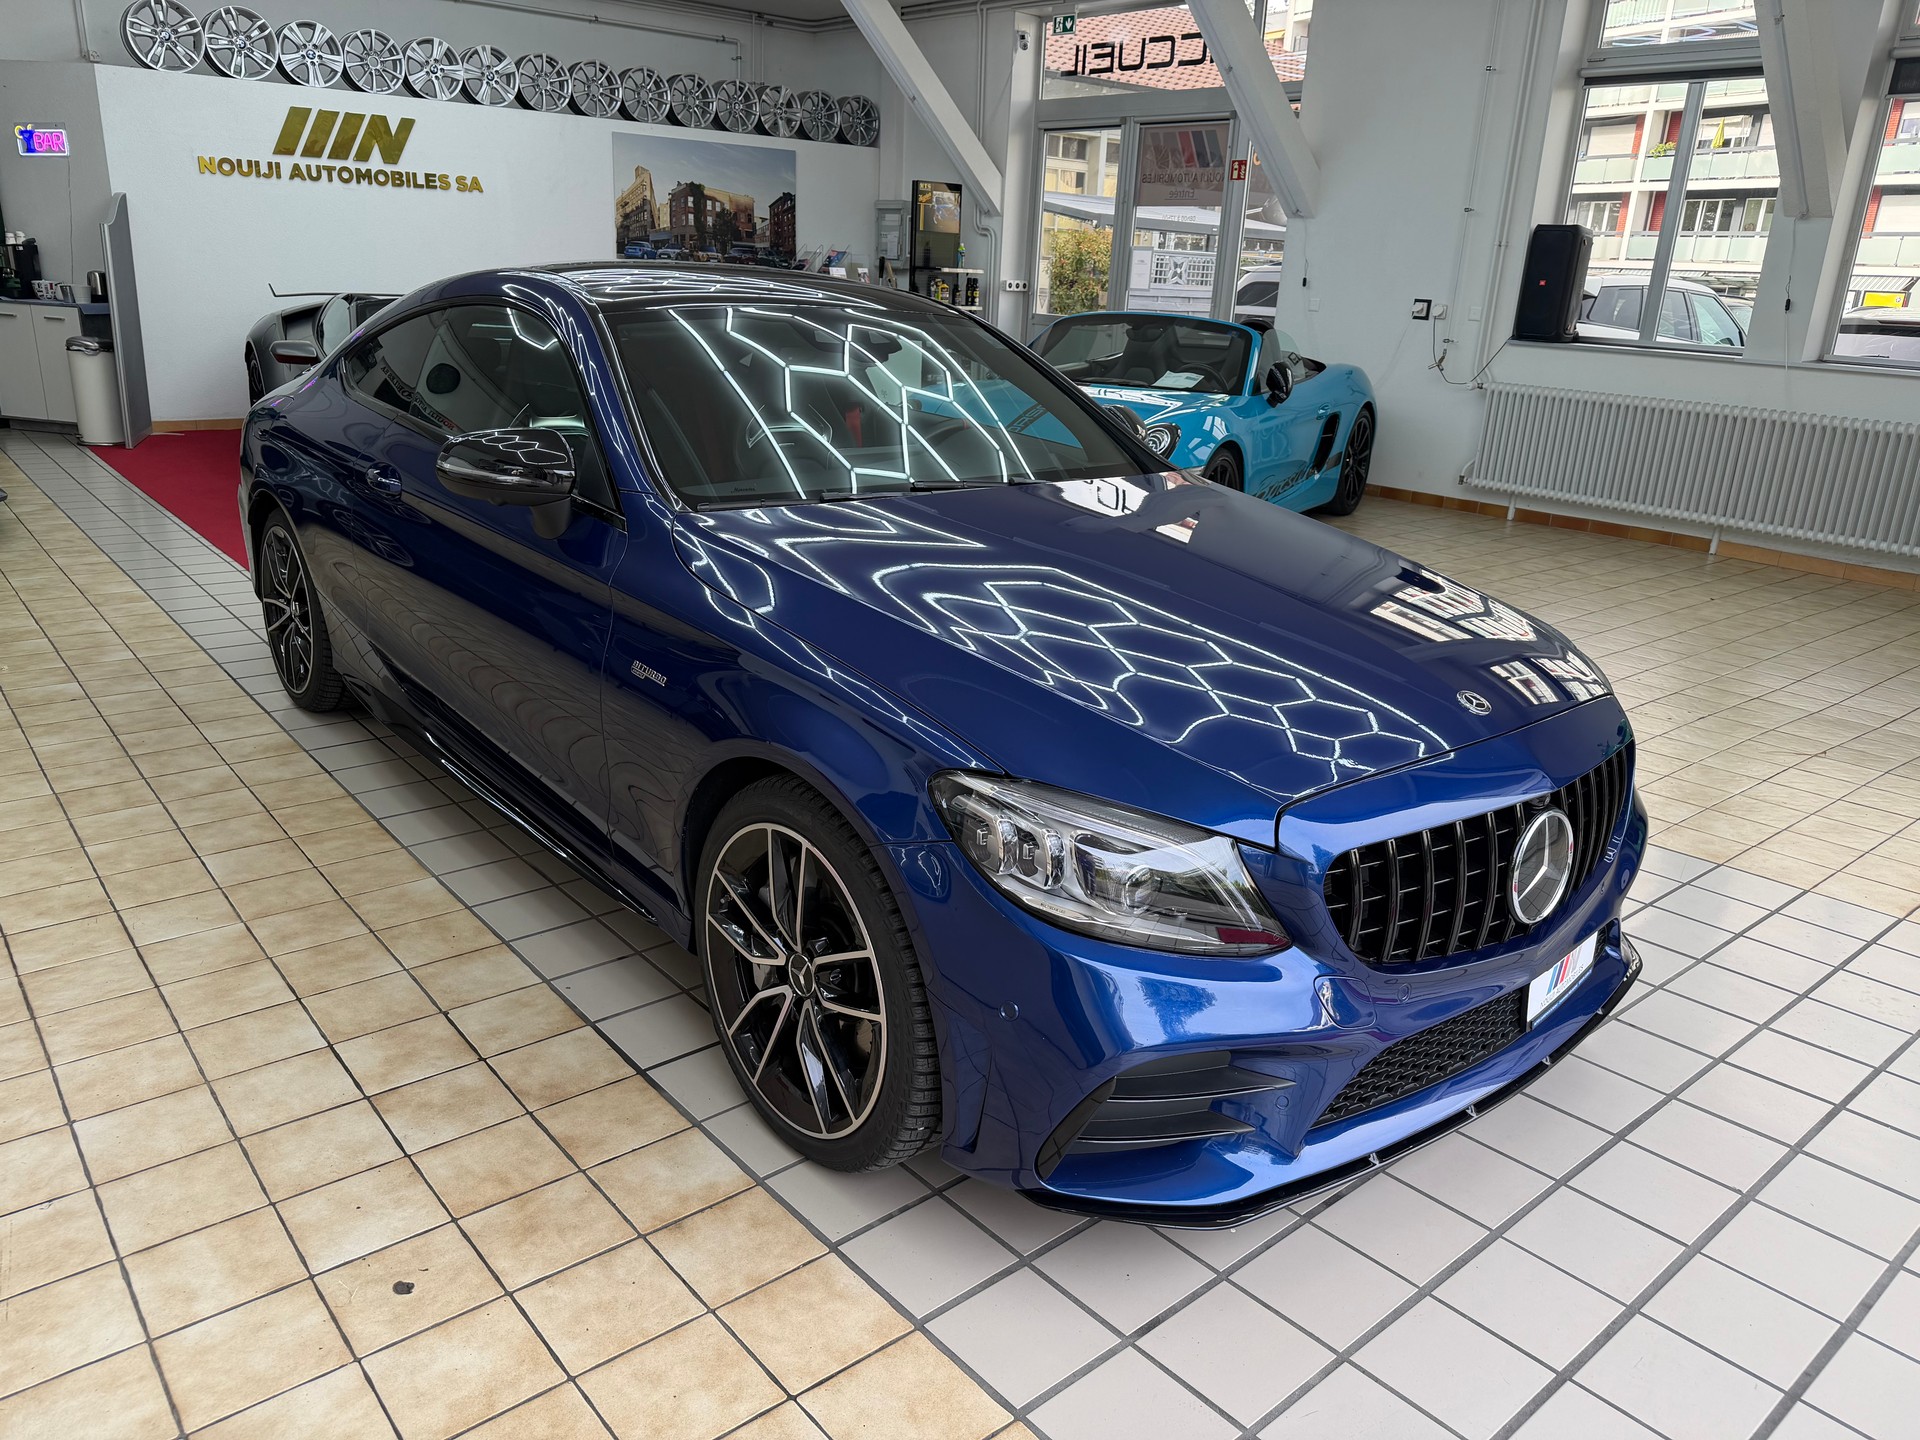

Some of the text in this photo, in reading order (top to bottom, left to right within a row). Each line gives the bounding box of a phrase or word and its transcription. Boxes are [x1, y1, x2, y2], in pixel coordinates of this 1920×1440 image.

[33, 132, 65, 151] BAR
[198, 156, 483, 193] NOUIJI AUTOMOBILES SA
